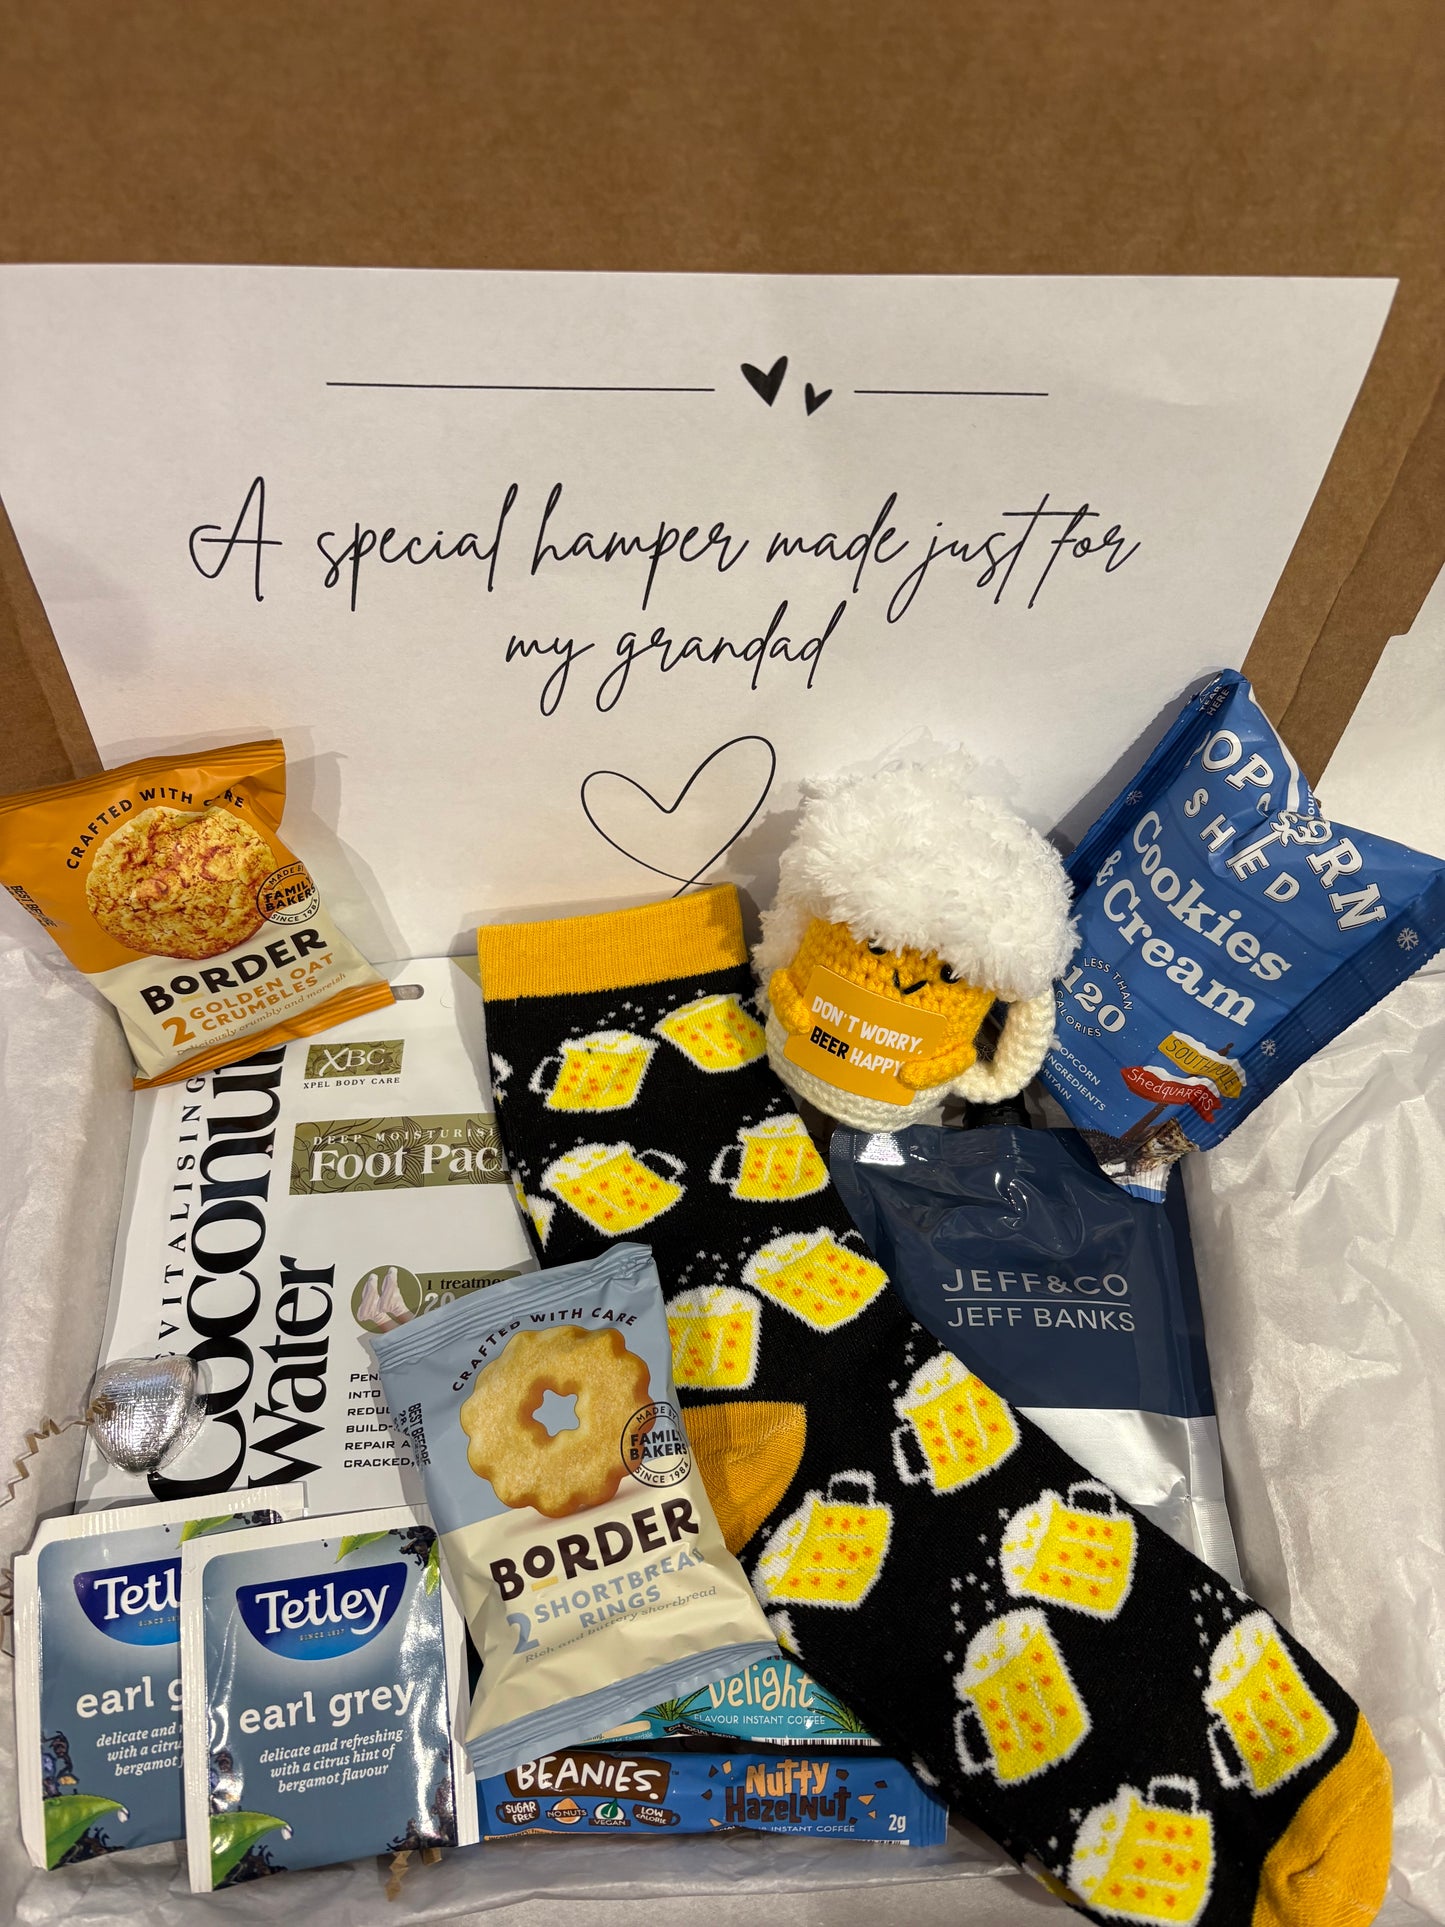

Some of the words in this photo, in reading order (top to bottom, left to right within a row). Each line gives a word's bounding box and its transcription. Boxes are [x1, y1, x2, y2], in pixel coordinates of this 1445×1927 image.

[189, 476, 283, 602] A
[317, 483, 519, 612] special
[531, 483, 749, 611] hamper
[766, 492, 909, 593] made
[887, 493, 1080, 623] just
[1028, 503, 1141, 609] for
[505, 634, 595, 717] my
[596, 600, 847, 713] grandad
[1206, 688, 1230, 716] HERE
[66, 799, 133, 870] CRAFTED
[139, 787, 193, 804] WITH
[1183, 788, 1300, 903] SHED
[268, 867, 295, 886] MADE
[265, 883, 316, 912] BAKERS
[1133, 811, 1292, 981] Cookies
[271, 913, 300, 923] SINCE
[1103, 879, 1256, 1027] Cream
[139, 928, 328, 1016] BORDER
[1083, 957, 1111, 974] LESS
[1112, 971, 1134, 1011] THAN
[161, 1016, 196, 1047] 2
[189, 977, 283, 1020] GOLDEN
[289, 952, 334, 980] OAT
[201, 976, 319, 1032] CRUMBLES
[239, 1007, 282, 1032] crumbly
[284, 996, 305, 1010] and
[306, 973, 346, 1000] moreish
[1055, 990, 1102, 1038] CALORIES
[1060, 965, 1127, 1033] 120
[810, 1025, 850, 1060] BEER
[811, 996, 860, 1033] DON'T
[859, 1021, 924, 1055] WORRY,
[318, 1046, 386, 1078] XBC
[1060, 1047, 1101, 1086] OPCORN
[303, 1081, 330, 1090] XPEL
[336, 1078, 366, 1087] BODY
[371, 1077, 400, 1085] CARE
[1045, 1052, 1106, 1111] INGREDIENTS
[313, 1133, 362, 1146] DEEP
[310, 1145, 407, 1182] Foot
[154, 1077, 206, 1359] VITALISING
[440, 1276, 507, 1290] treatme
[941, 1268, 1129, 1297] JEFF&CO
[948, 1307, 1022, 1328] JEFF
[1033, 1308, 1136, 1333] BANKS
[452, 1320, 521, 1392] CRAFTED
[530, 1307, 583, 1323] WITH
[591, 1307, 638, 1326] CARE
[247, 1255, 336, 1490] Water
[350, 1373, 381, 1383] PEN
[348, 1390, 381, 1399] INTO
[408, 1402, 423, 1427] BEST
[635, 1405, 665, 1423] MADE
[343, 1457, 415, 1468] CRACKED,
[344, 1440, 395, 1450] REPAIR
[629, 1443, 688, 1461] BAKERS
[634, 1466, 665, 1483] SINCE
[669, 1461, 689, 1481] 1984
[489, 1497, 700, 1602] BORDER
[93, 1568, 181, 1620] Tetl
[255, 1582, 391, 1635] Tetley
[506, 1612, 540, 1655] 2
[534, 1547, 706, 1624] SHORTBREAD
[579, 1585, 661, 1629] RINGS
[525, 1646, 555, 1664] Rich
[557, 1632, 584, 1649] and
[641, 1586, 717, 1616] shortbread
[76, 1675, 155, 1718] earl
[239, 1690, 316, 1734] earl
[328, 1680, 416, 1727] grey
[96, 1729, 149, 1747] delicate
[151, 1722, 176, 1738] and
[694, 1714, 739, 1725] FLAVOUR
[742, 1715, 784, 1725] INSTANT
[787, 1715, 826, 1725] COFFEE
[107, 1745, 138, 1762] with
[140, 1745, 148, 1756] a
[151, 1739, 183, 1754] citru
[259, 1745, 311, 1764] delicate
[313, 1738, 338, 1754] and
[340, 1728, 404, 1750] refreshing
[270, 1761, 300, 1779] with
[302, 1761, 311, 1772] a
[313, 1754, 350, 1771] citrus
[352, 1749, 380, 1764] hint
[381, 1744, 396, 1761] of
[114, 1756, 178, 1777] bergamot
[277, 1772, 340, 1793] bergamot
[341, 1763, 389, 1786] flavour
[505, 1801, 537, 1814] SUGAR
[512, 1812, 535, 1824] FREE
[547, 1810, 562, 1818] NO
[563, 1809, 587, 1817] NUTS
[594, 1818, 627, 1827] VEGAN
[641, 1806, 664, 1818] LOW
[888, 1814, 907, 1834] 2g
[771, 1825, 813, 1833] INSTANT
[815, 1825, 856, 1833] COFFEE
